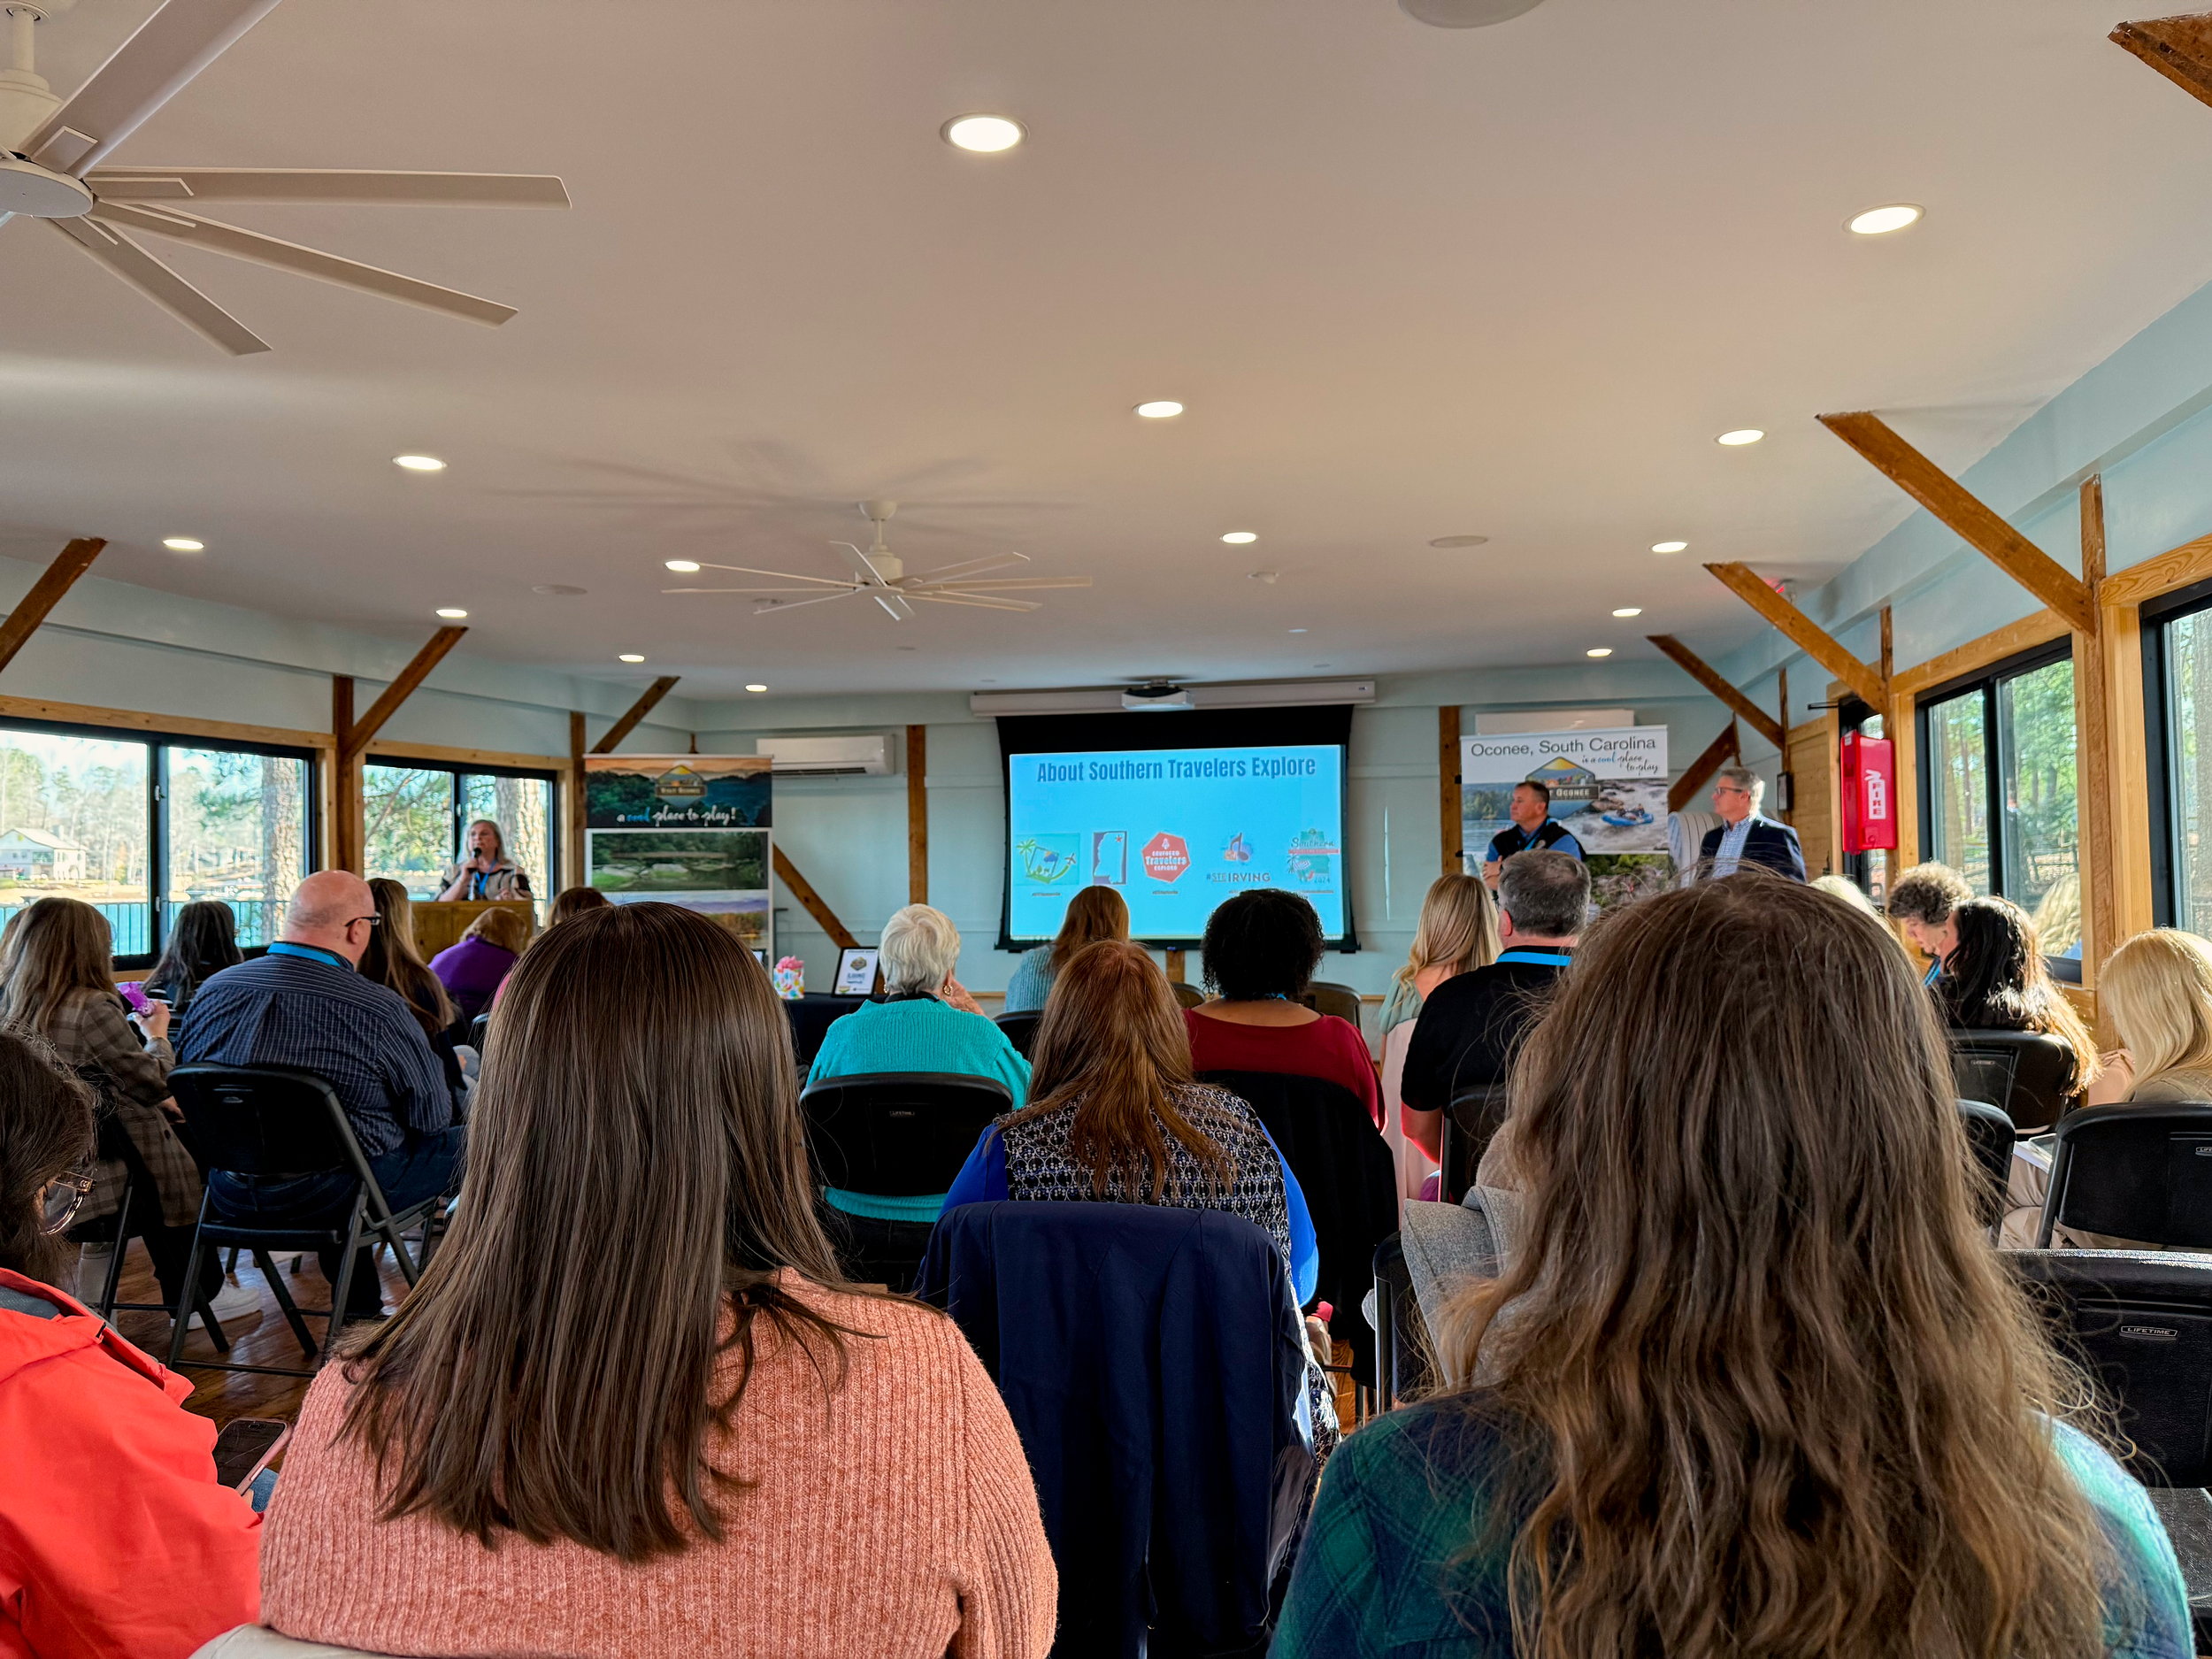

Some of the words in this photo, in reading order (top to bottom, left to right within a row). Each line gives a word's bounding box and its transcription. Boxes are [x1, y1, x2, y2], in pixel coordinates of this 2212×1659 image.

[1471, 742, 1533, 757] Oconee,
[1539, 740, 1584, 753] South
[1589, 736, 1656, 751] Carolina
[1037, 762, 1084, 782] About
[1088, 760, 1163, 781] Southern
[1168, 757, 1246, 779] Travelers
[1252, 757, 1316, 779] Explore
[1617, 751, 1642, 768] place
[1635, 759, 1659, 776] play
[1872, 782, 1882, 815] FIRE
[652, 804, 685, 827] place
[686, 808, 699, 821] to
[701, 804, 736, 827] play!
